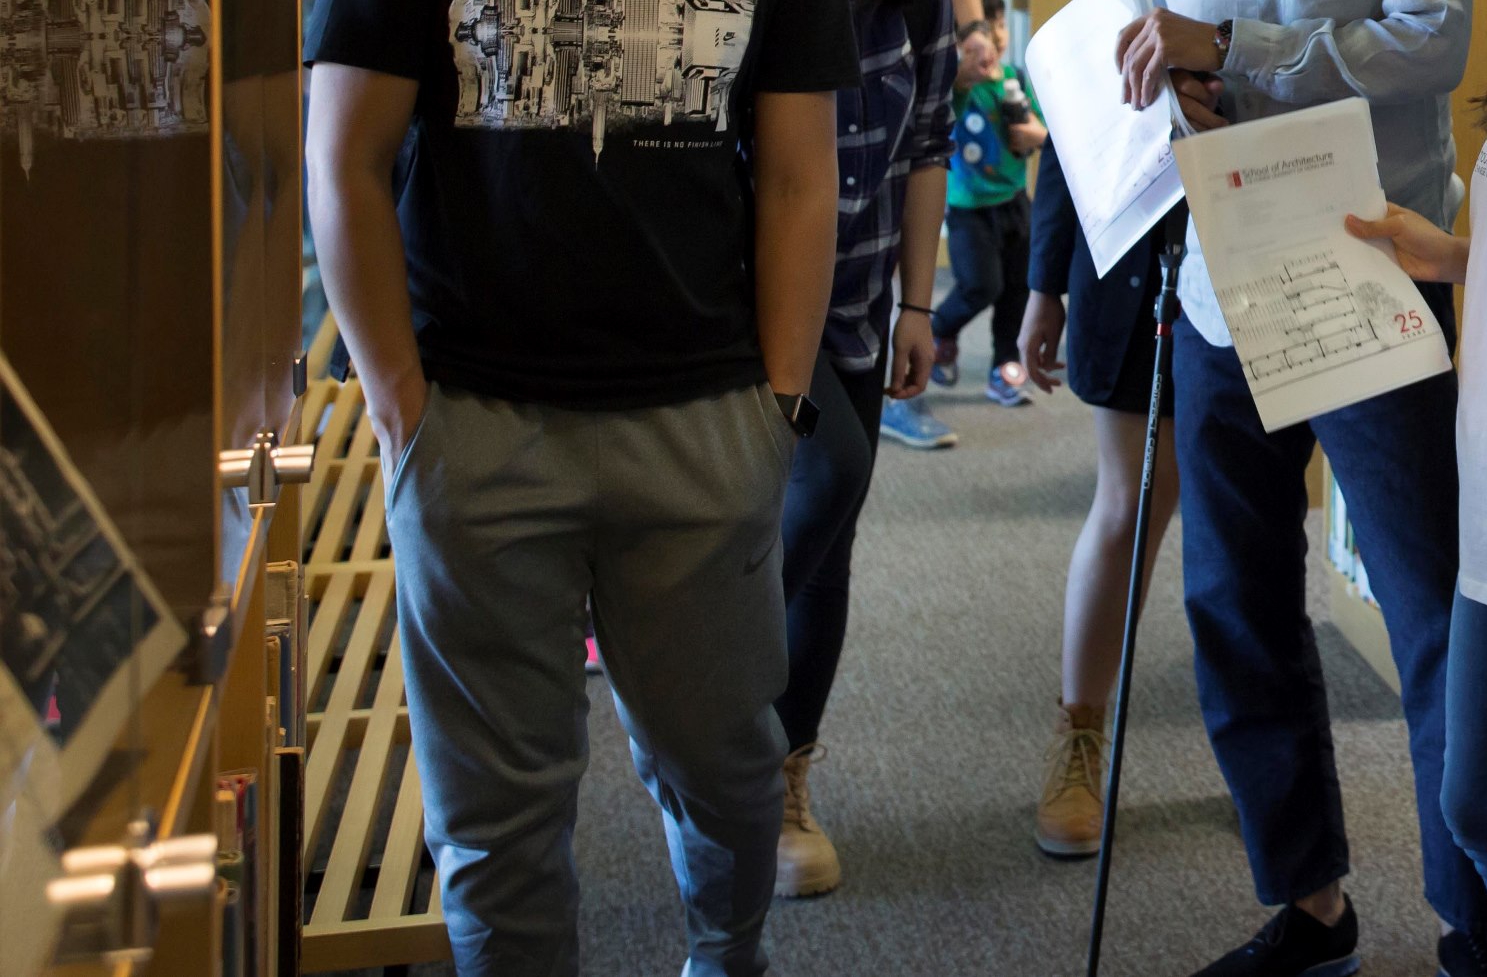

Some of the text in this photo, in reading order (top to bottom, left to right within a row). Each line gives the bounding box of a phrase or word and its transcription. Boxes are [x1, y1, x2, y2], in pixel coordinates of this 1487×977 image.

[632, 139, 661, 148] THERE
[674, 140, 685, 148] NO
[1241, 164, 1269, 179] School
[1281, 151, 1335, 171] Architecture
[1393, 309, 1424, 335] 25
